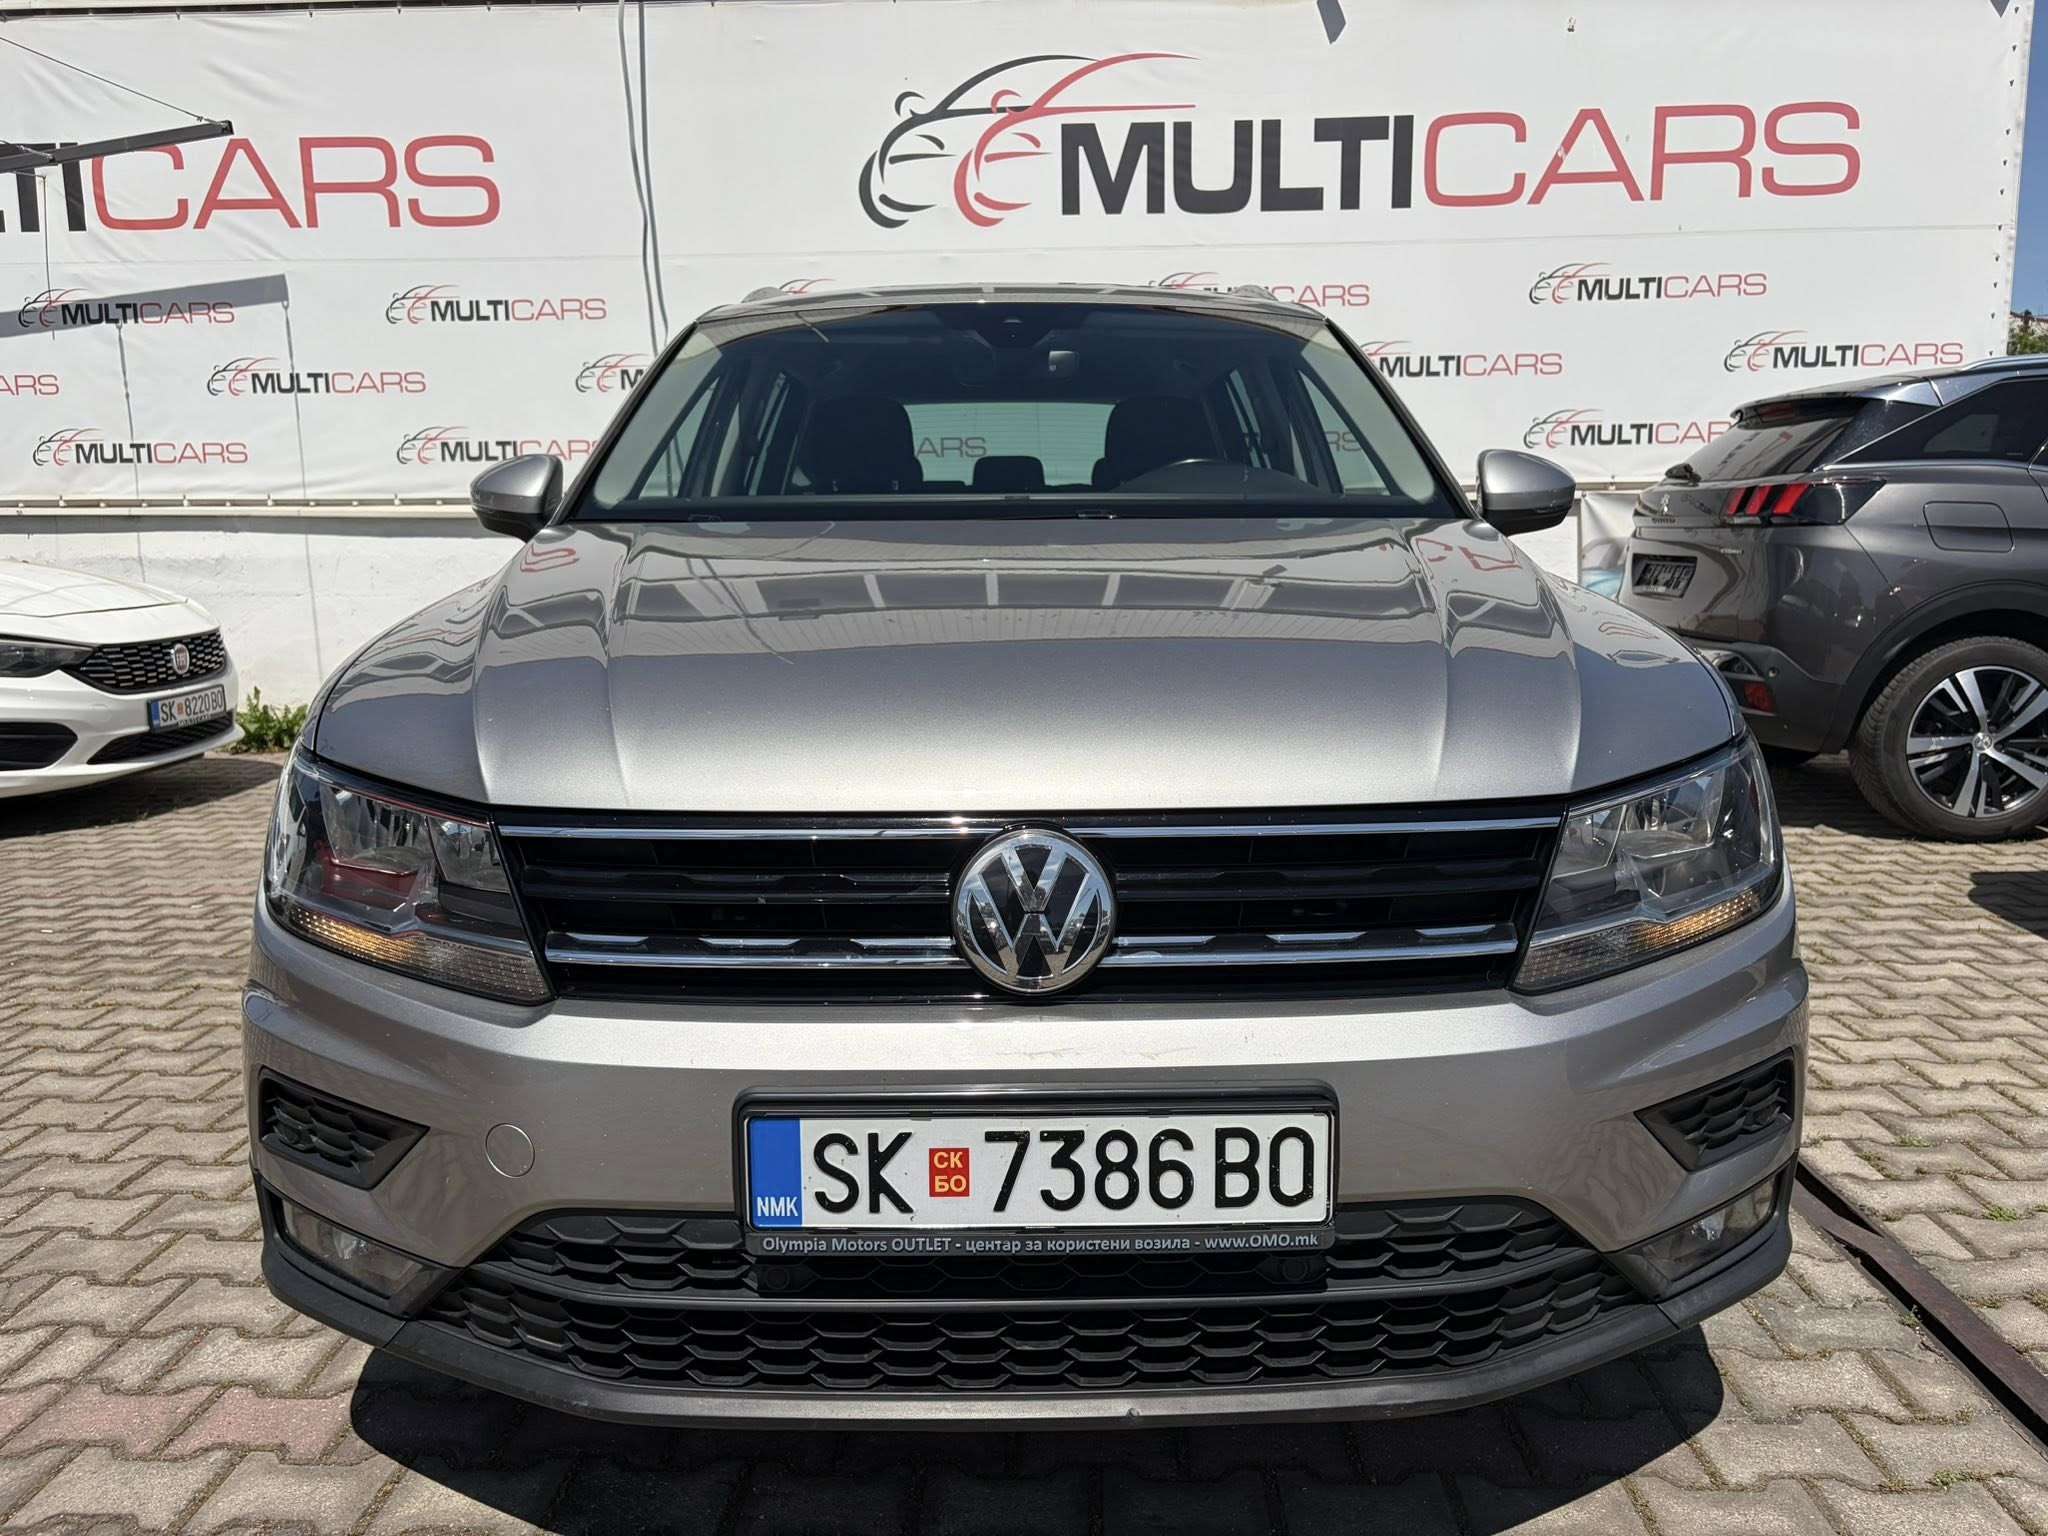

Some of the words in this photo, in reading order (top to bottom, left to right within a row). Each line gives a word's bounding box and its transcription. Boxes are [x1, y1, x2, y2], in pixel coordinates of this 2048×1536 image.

[1060, 101, 1861, 216] MULTICARS
[0, 135, 501, 233] TICARS
[1577, 273, 1767, 301] MULTICARS
[62, 302, 235, 325] MULTICARS
[431, 298, 607, 322] MULTICARS
[1380, 353, 1562, 378] MULTICARS
[1773, 343, 1964, 369] MULTICARS
[251, 371, 426, 395] MULTICARS
[75, 442, 248, 464] MULTICARS
[438, 440, 598, 462] MULTICAR
[160, 700, 176, 722] SK
[933, 1151, 964, 1169] СК
[813, 1132, 914, 1214] SK
[934, 1174, 967, 1193] БО
[756, 1196, 798, 1217] NMK
[763, 1236, 827, 1254] Olympia
[832, 1236, 888, 1251] Motors
[892, 1236, 952, 1251] OUTLET
[965, 1240, 1021, 1253] центар
[1025, 1240, 1042, 1250] за
[1048, 1239, 1130, 1253] користени
[1135, 1238, 1190, 1250] возила
[1204, 1234, 1319, 1249] www.OMO.mk
